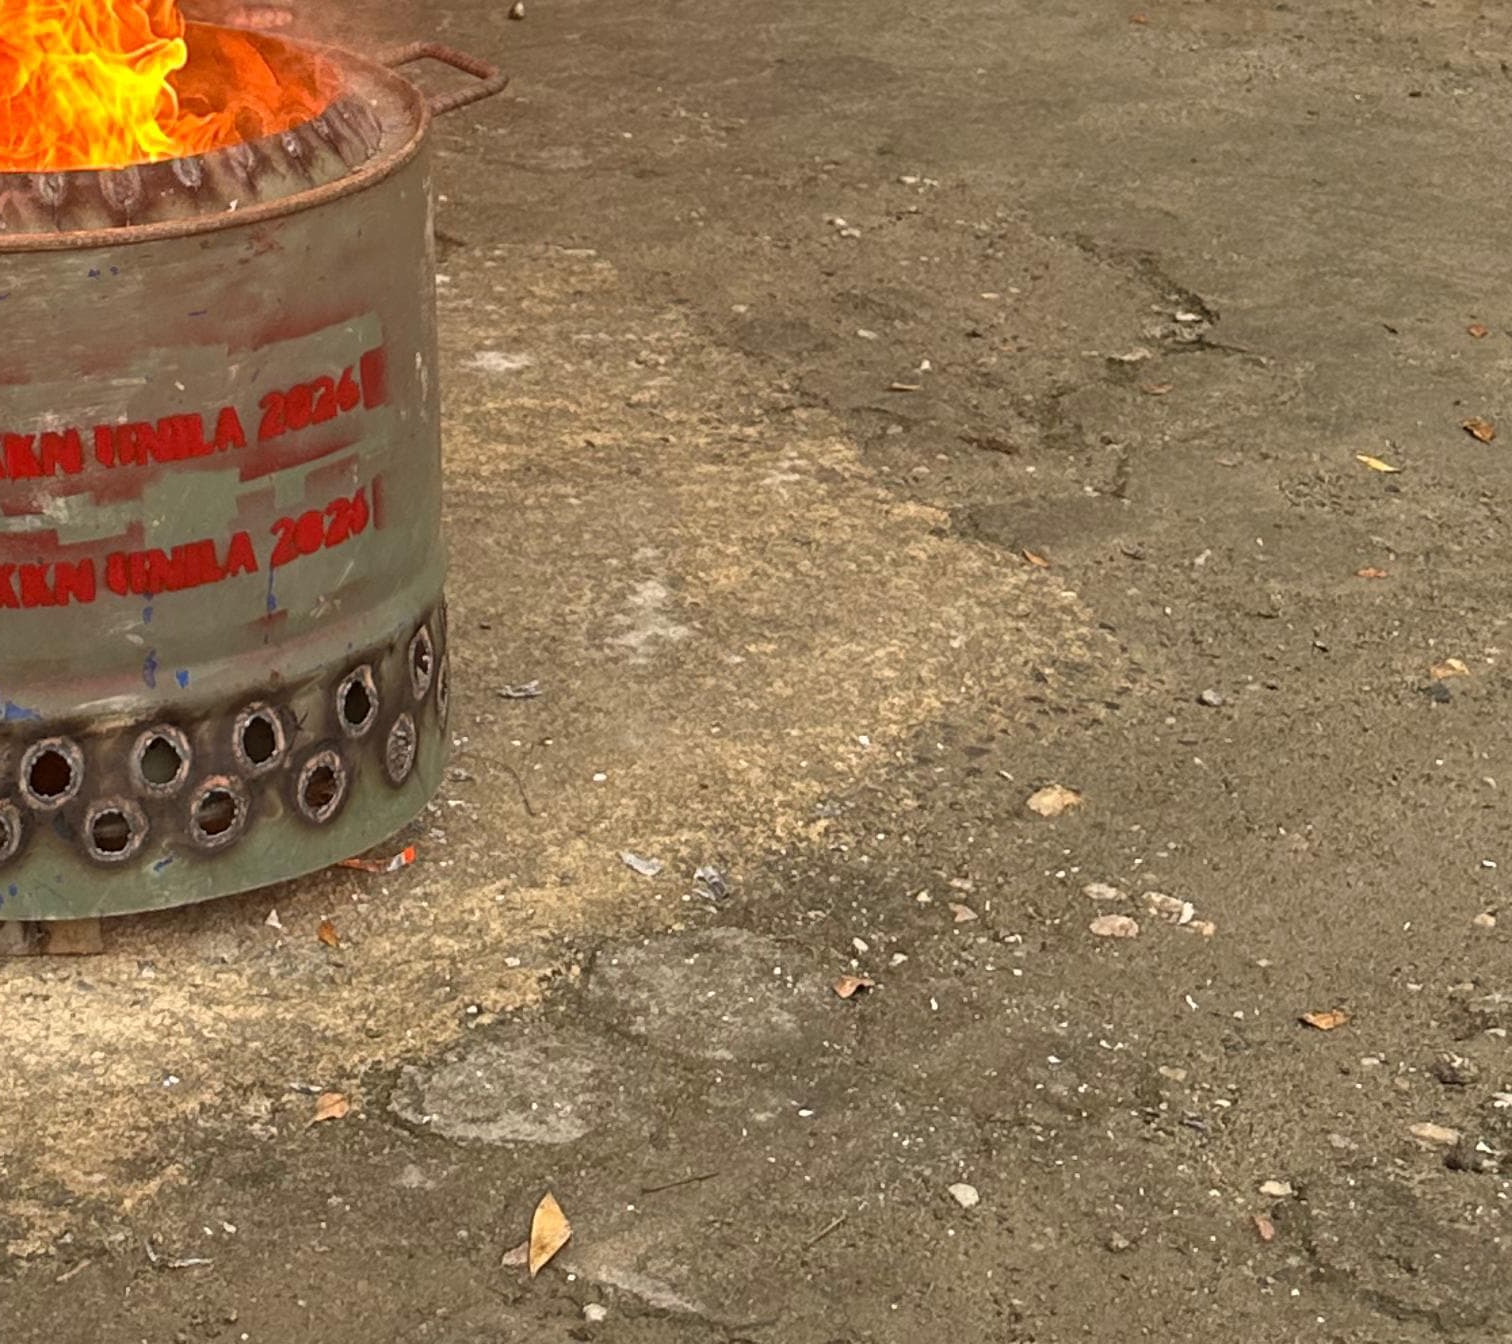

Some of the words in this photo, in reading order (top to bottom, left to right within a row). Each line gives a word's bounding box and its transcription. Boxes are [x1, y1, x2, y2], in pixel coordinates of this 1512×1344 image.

[93, 405, 247, 469] UNILA
[258, 365, 360, 442] 2026
[106, 531, 256, 596] UNILA
[270, 487, 370, 569] 2026
